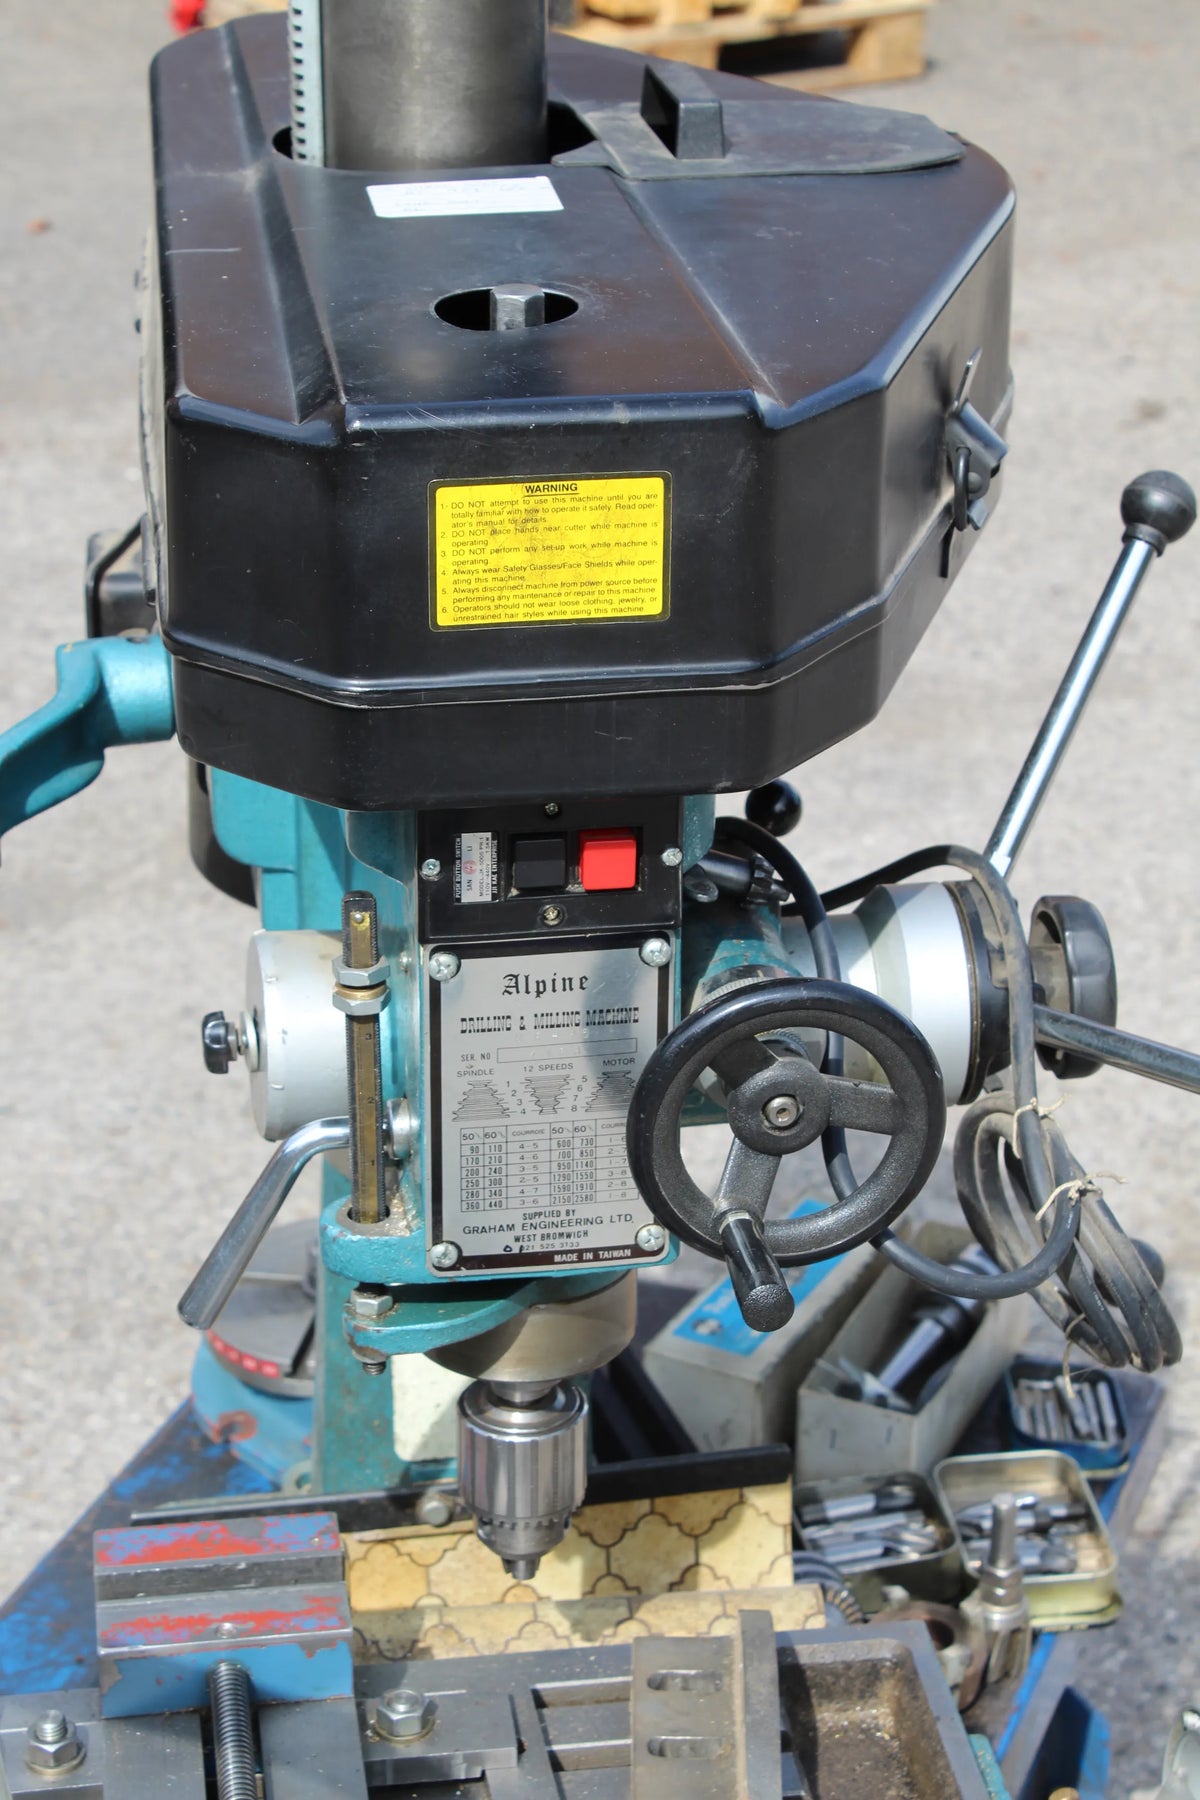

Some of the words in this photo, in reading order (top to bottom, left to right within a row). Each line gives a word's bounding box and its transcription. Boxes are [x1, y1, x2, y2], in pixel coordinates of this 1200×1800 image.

[525, 483, 578, 494] WARNING
[490, 528, 511, 536] place
[490, 546, 520, 554] perform
[542, 542, 565, 550] set-up
[530, 562, 582, 570] Glasses/Face
[526, 580, 558, 588] machine
[453, 595, 494, 604] performing
[512, 592, 562, 600] maintenance
[453, 605, 491, 614] Operators
[453, 612, 501, 622] unrestrained
[502, 973, 589, 998] Alpine
[460, 1015, 511, 1033] DRILLING
[519, 1016, 526, 1030] &
[534, 1011, 580, 1029] MILLING
[586, 1007, 639, 1026] MACHINE
[603, 1058, 635, 1066] MOTOR
[457, 1069, 494, 1077] SPINDLE
[488, 1156, 502, 1164] 210
[580, 1149, 593, 1157] 850
[465, 1168, 479, 1176] 200
[488, 1167, 502, 1175] 240
[466, 1180, 479, 1188] 250
[489, 1178, 502, 1186] 300
[576, 1172, 593, 1180] 1550
[466, 1191, 479, 1199] 280
[523, 1211, 561, 1220] SUPPLIED
[463, 1224, 515, 1234] GRAHAM
[522, 1217, 603, 1230] ENGINEERING
[514, 1234, 537, 1242] WEST
[540, 1230, 588, 1241] BROMWICH
[554, 1254, 578, 1262] MADE
[600, 1250, 631, 1258] TAIWAN
